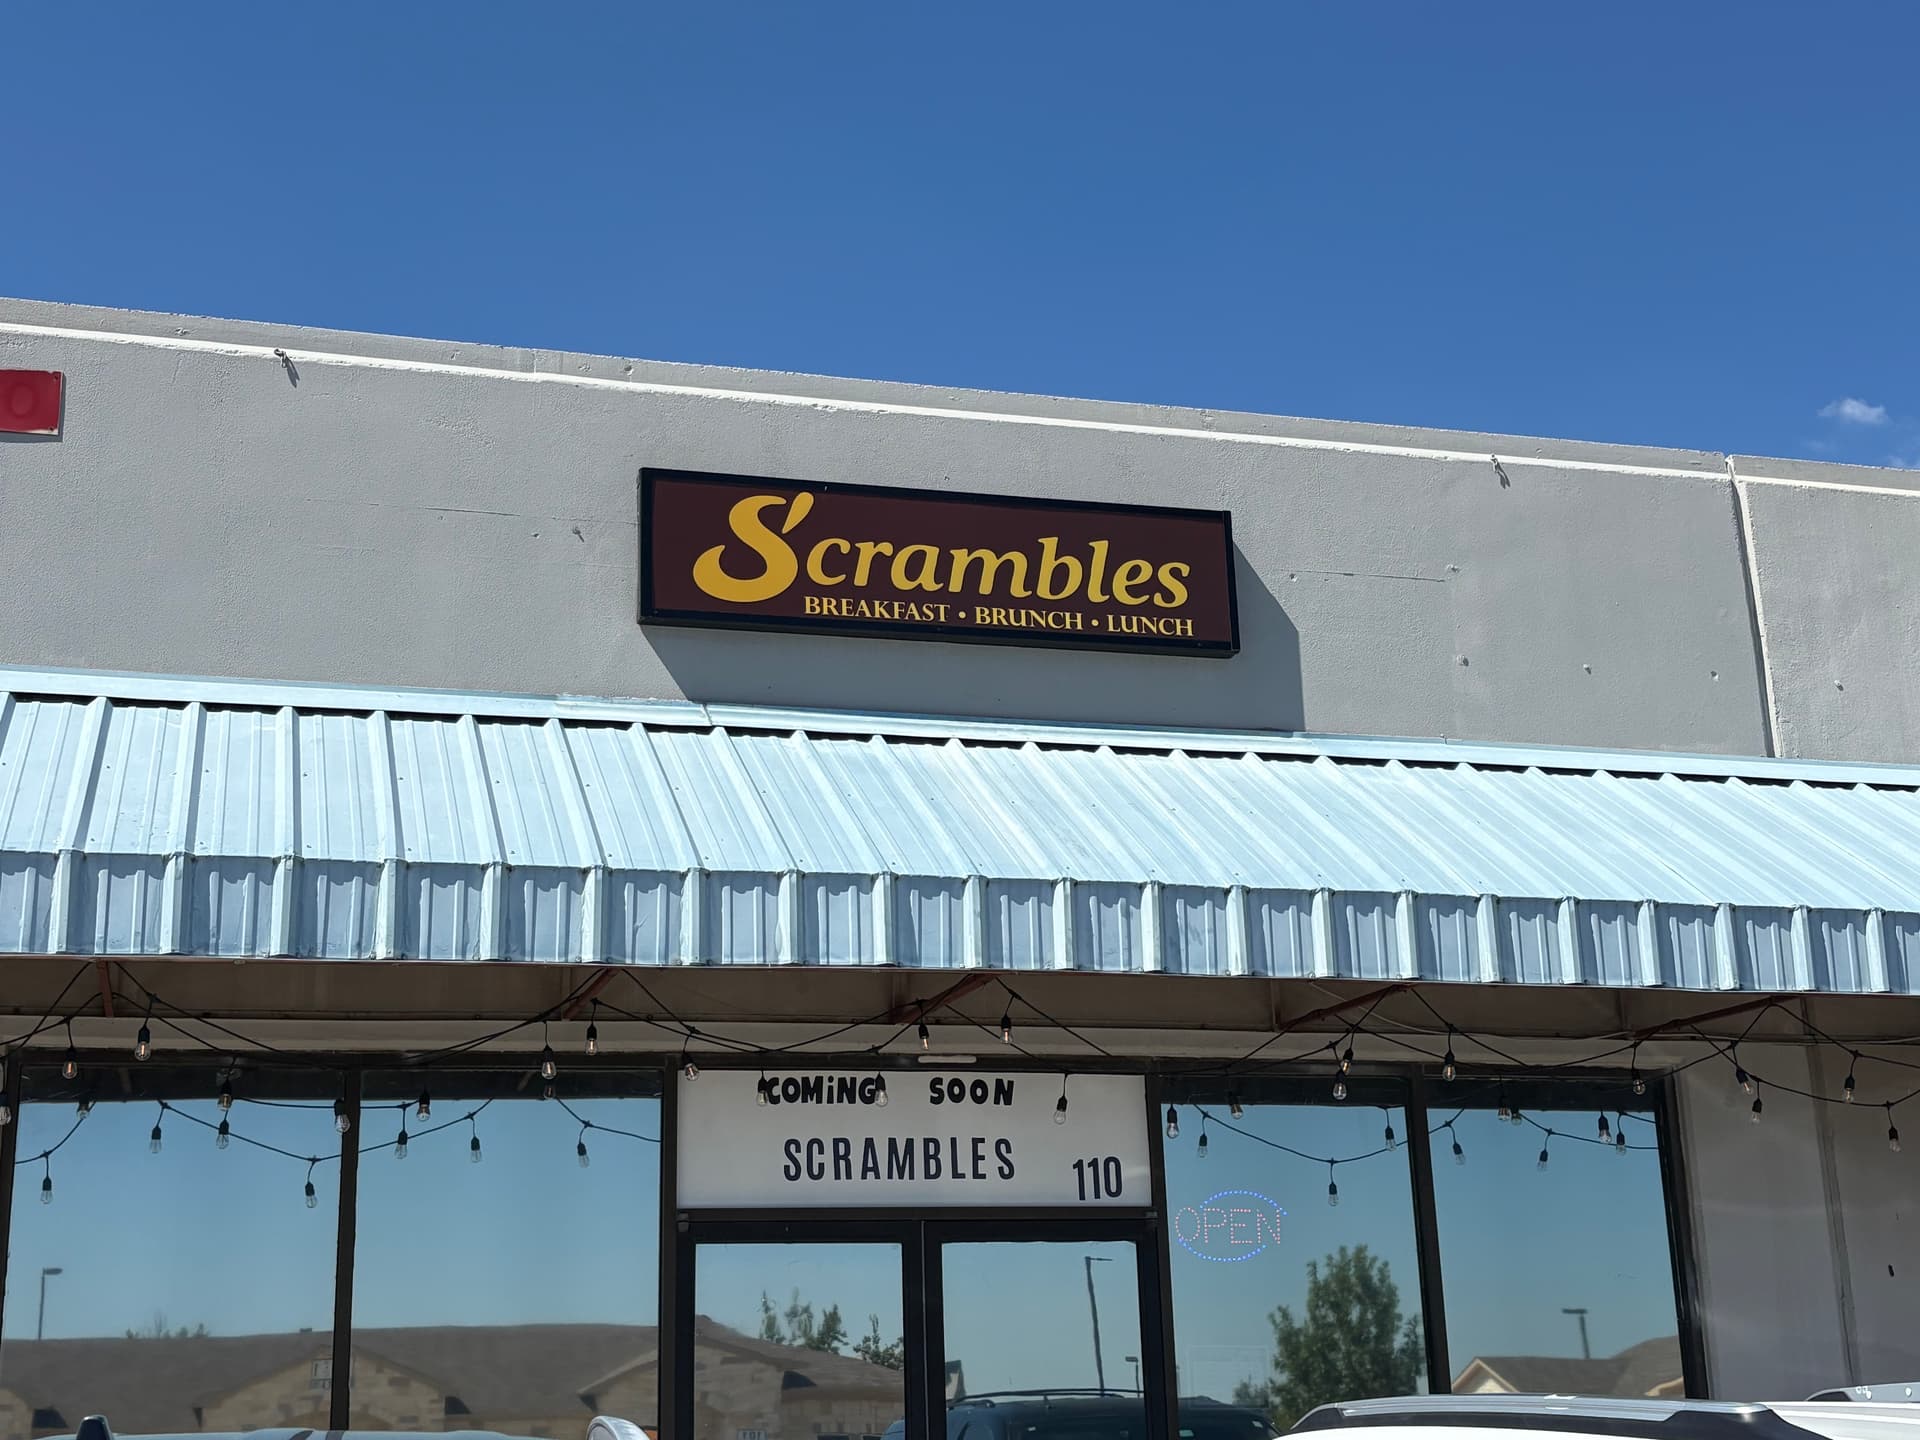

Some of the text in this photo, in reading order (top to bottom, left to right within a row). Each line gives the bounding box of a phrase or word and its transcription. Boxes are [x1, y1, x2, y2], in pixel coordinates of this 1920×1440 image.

[693, 491, 1191, 607] Scrambles
[804, 596, 1194, 636] BREAKFAST BRUNCH LUNCH
[929, 1077, 1014, 1105] SOON
[783, 1137, 1016, 1181] SCRAMBLES
[1072, 1156, 1123, 1201] 110
[1175, 1206, 1281, 1244] OPEN
